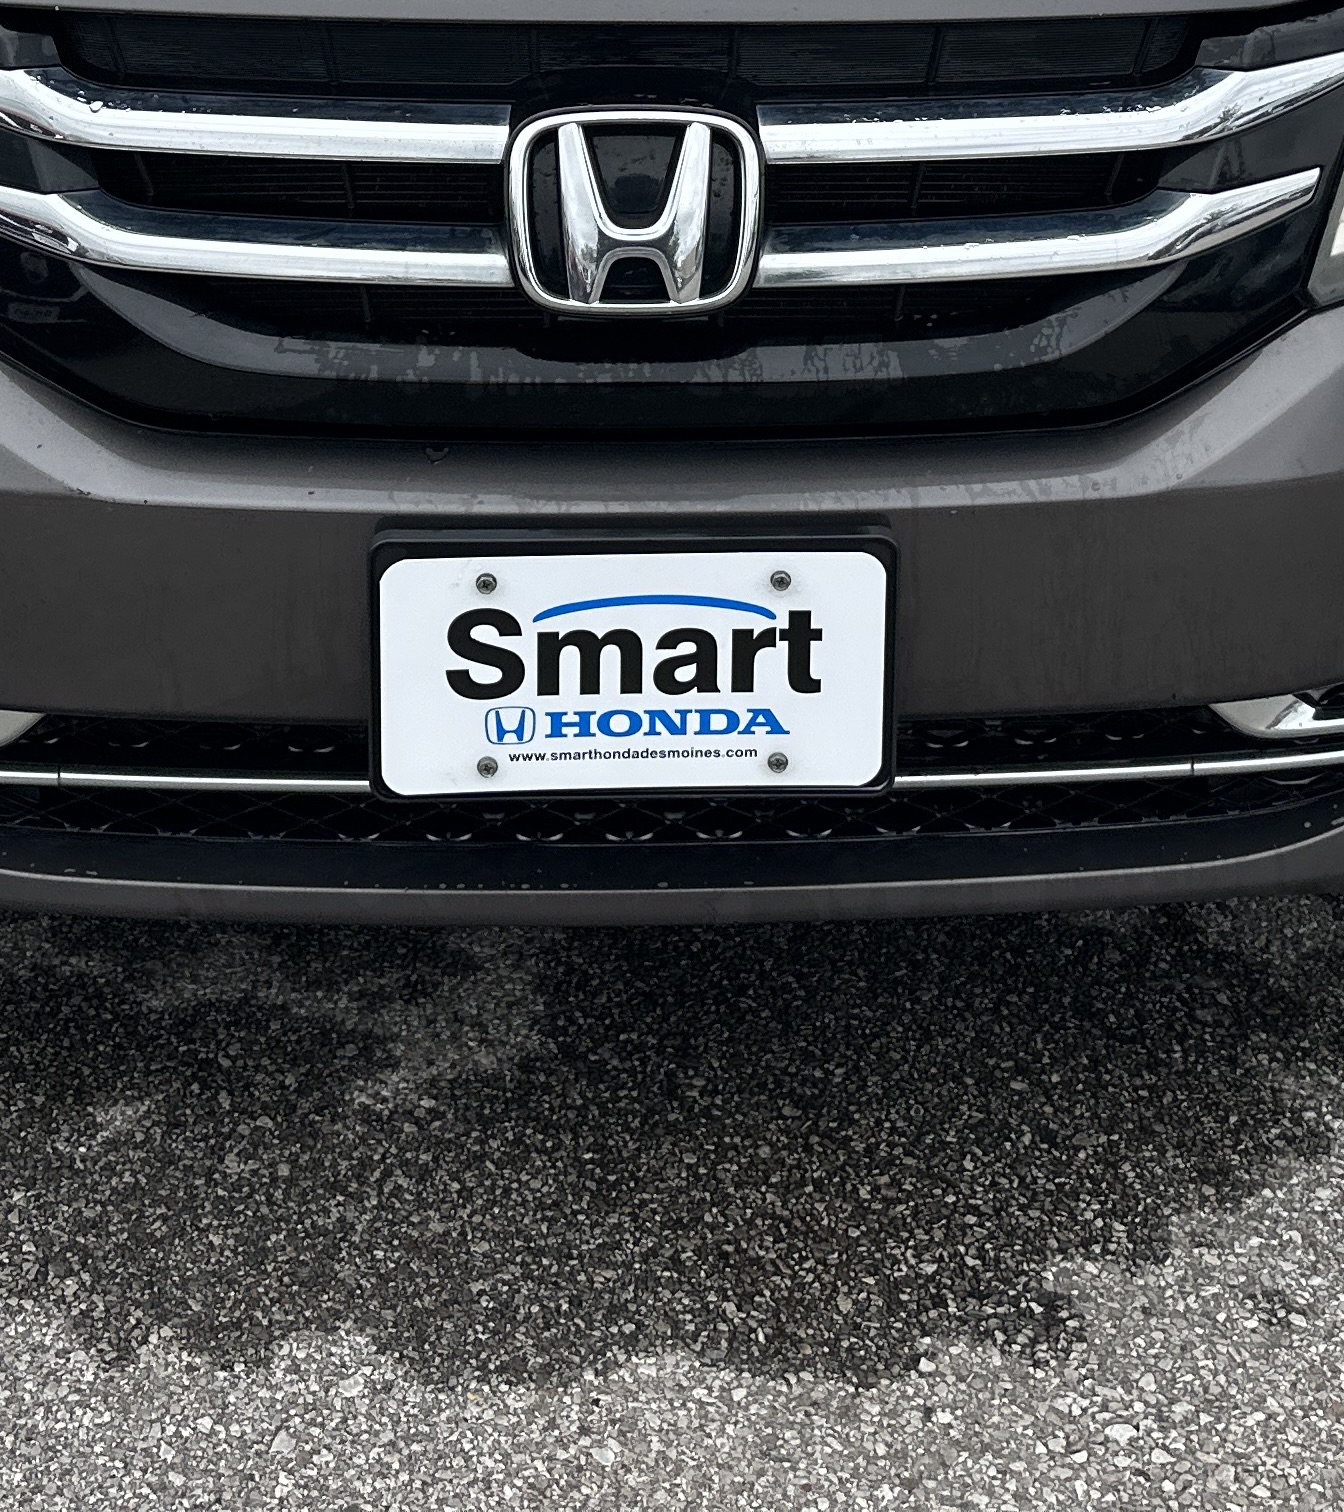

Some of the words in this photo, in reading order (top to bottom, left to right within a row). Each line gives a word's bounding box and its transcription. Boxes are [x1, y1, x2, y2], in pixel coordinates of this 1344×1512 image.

[445, 607, 824, 701] Smart
[544, 708, 791, 738] HONDA
[507, 745, 758, 764] www.smarthondadesmoines.com
